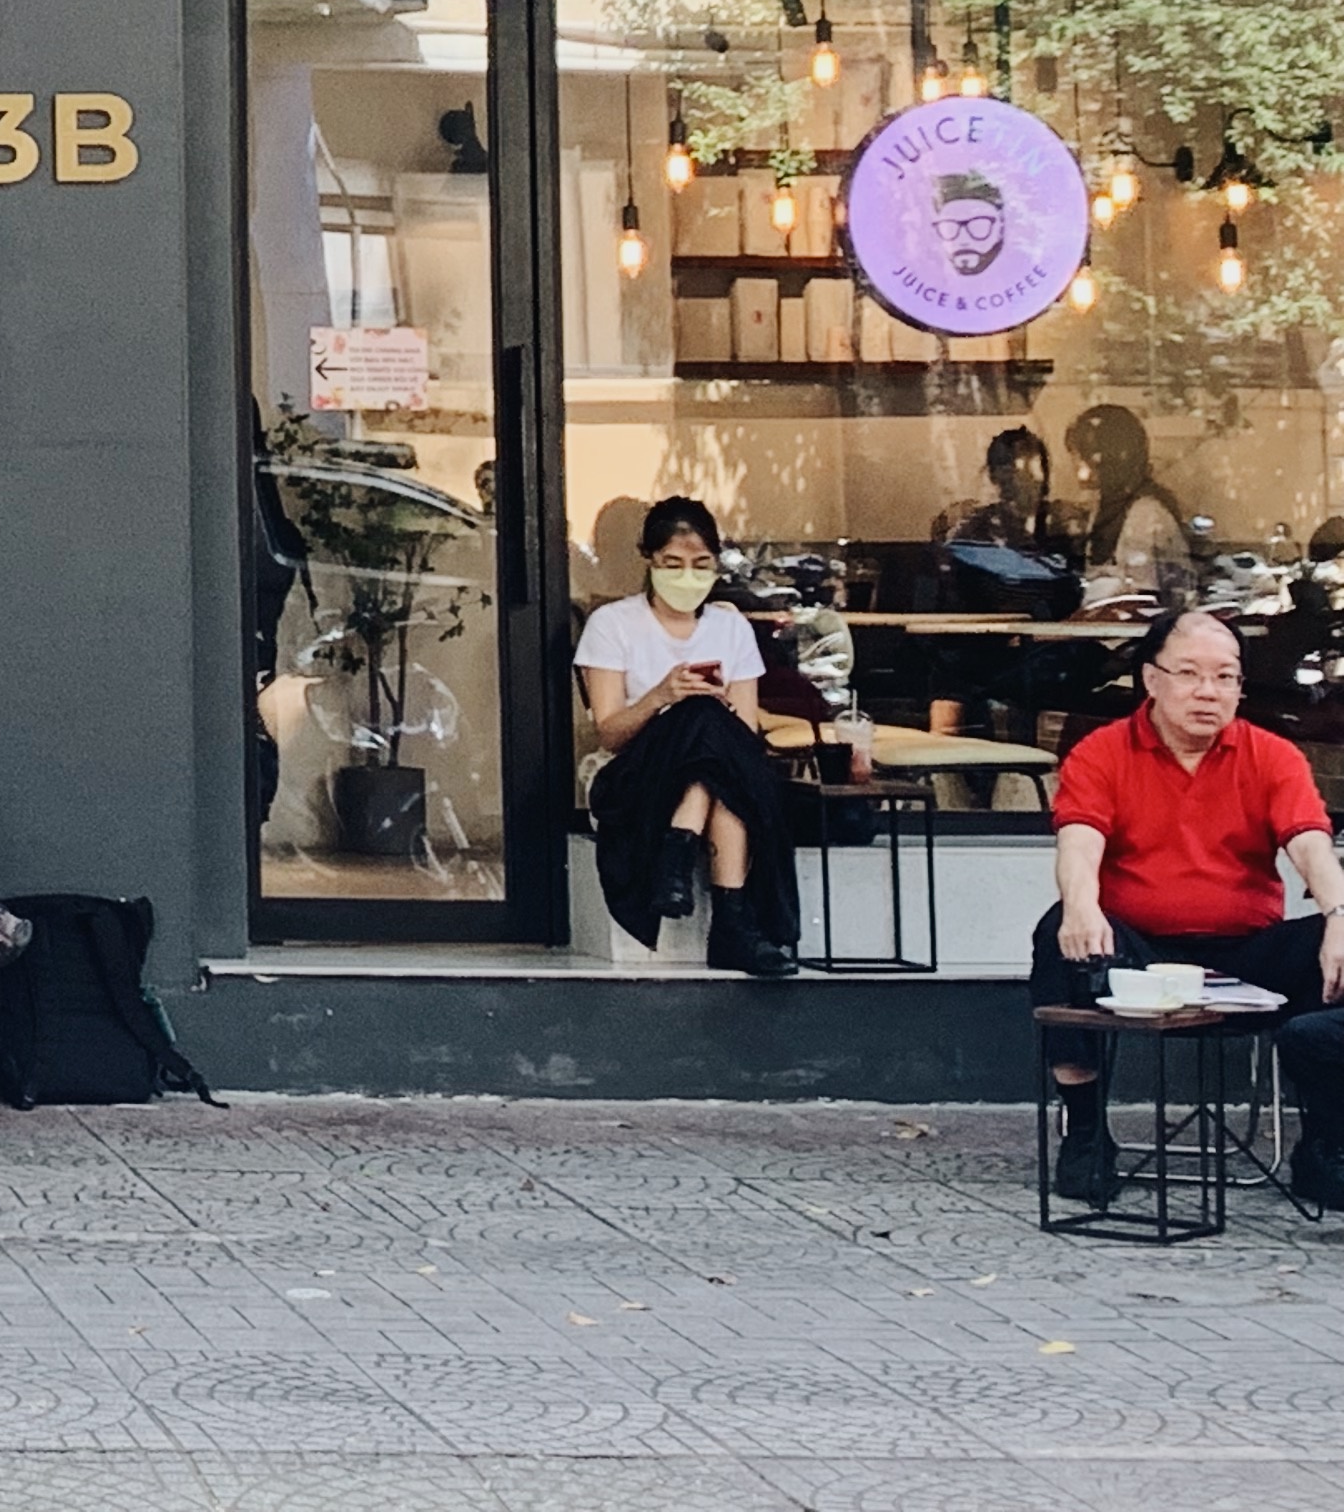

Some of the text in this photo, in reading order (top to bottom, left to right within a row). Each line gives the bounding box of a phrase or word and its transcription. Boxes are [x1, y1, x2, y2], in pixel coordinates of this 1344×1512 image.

[892, 264, 1048, 311] JUICE & COFFEE
